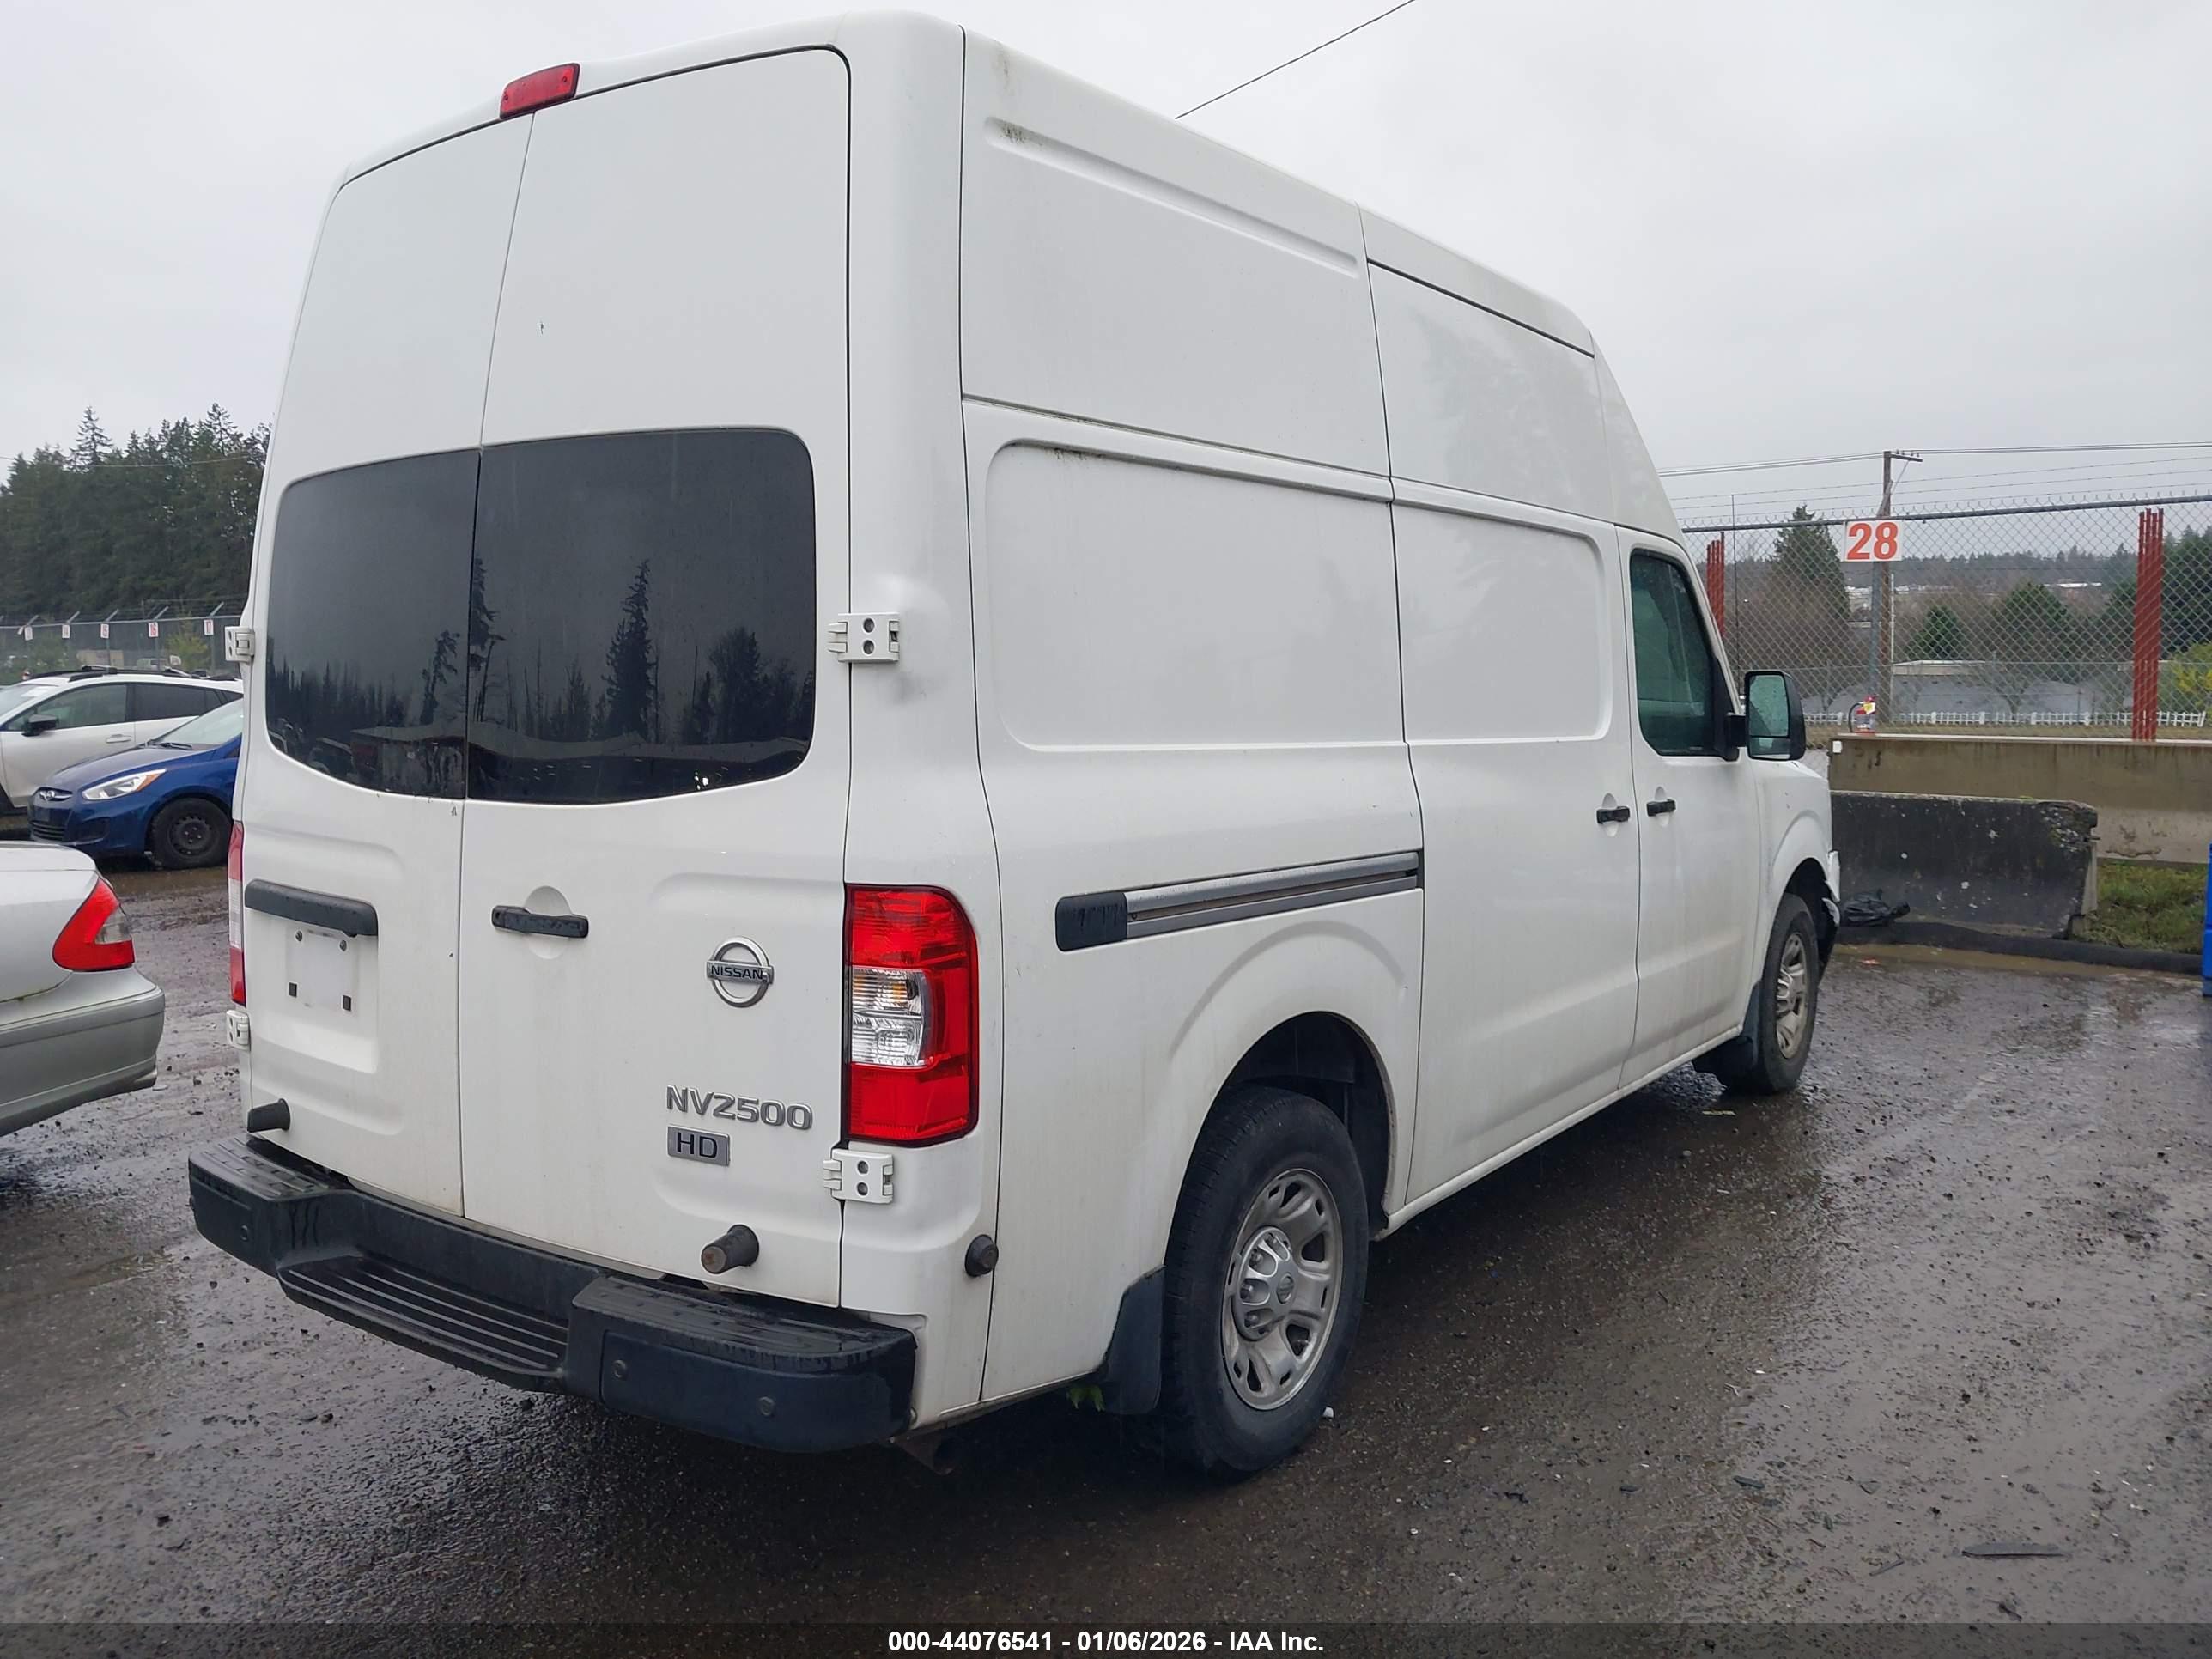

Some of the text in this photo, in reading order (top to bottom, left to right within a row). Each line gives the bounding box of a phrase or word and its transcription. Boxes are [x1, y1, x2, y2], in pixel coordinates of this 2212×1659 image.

[1847, 522, 1898, 560] 28
[711, 965, 763, 980] NISSAN
[666, 1085, 813, 1130] NV2500
[677, 1132, 718, 1158] HD
